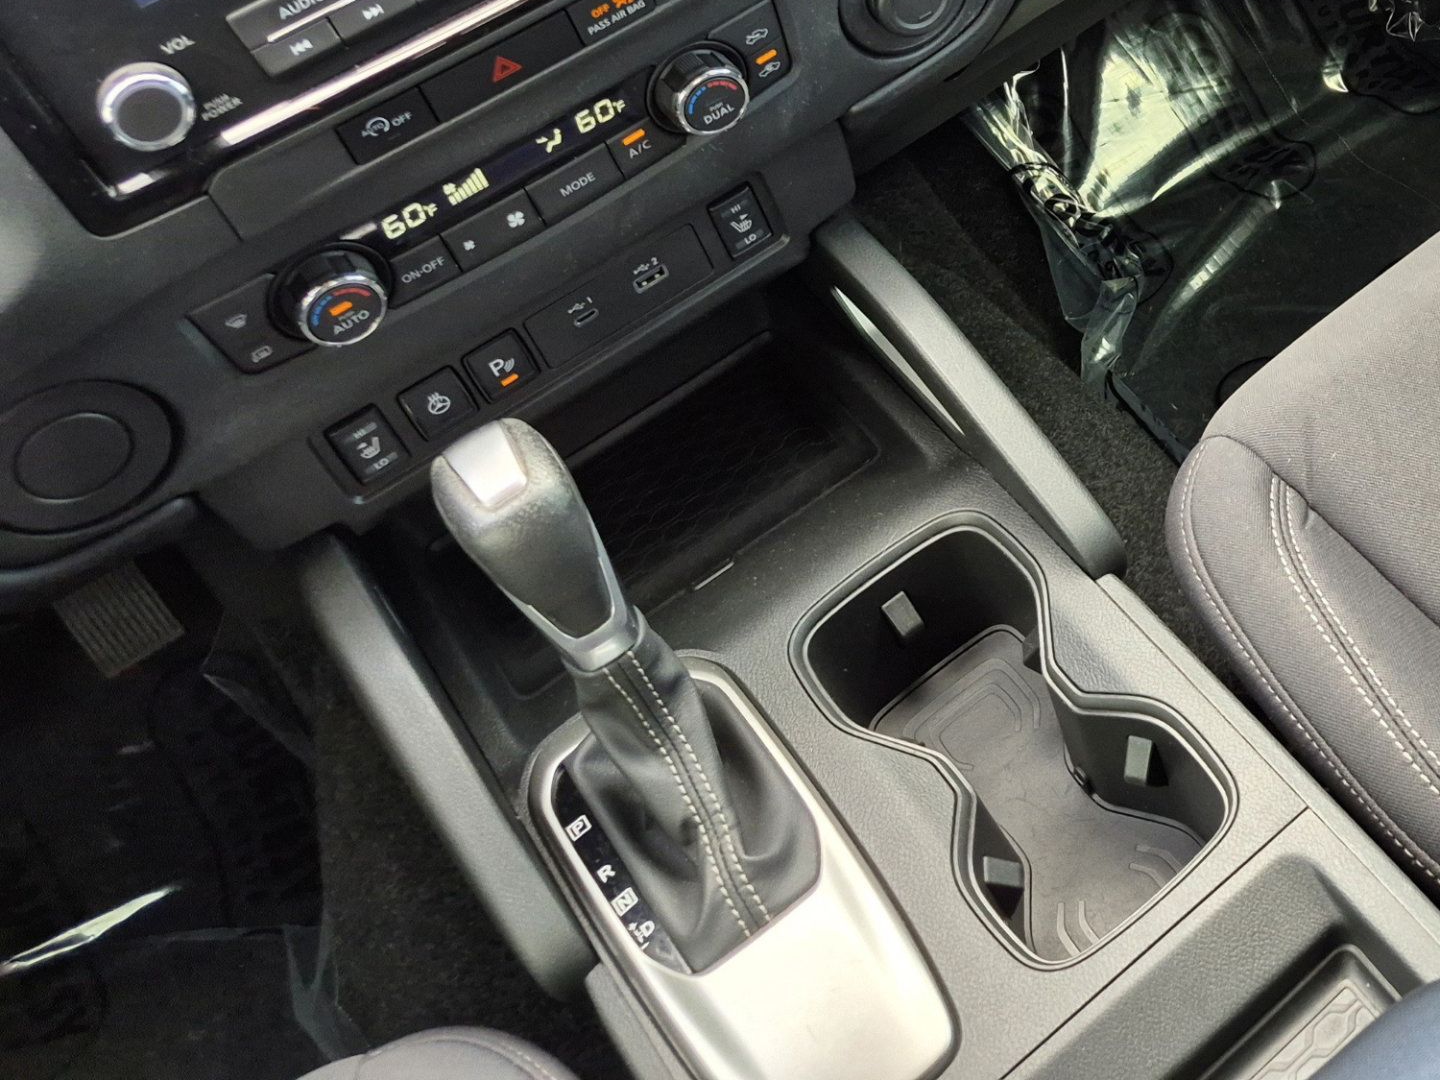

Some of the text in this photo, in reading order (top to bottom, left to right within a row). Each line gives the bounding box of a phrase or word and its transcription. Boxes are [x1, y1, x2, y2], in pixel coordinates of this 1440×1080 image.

[587, 0, 646, 35] PASS AIR BAG
[591, 3, 610, 18] OFF
[159, 35, 195, 55] VOL
[703, 104, 735, 125] DUAL
[628, 139, 652, 159] A/C
[559, 171, 596, 198] MODE
[744, 233, 758, 245] LO
[333, 309, 370, 336] AUTO
[597, 864, 616, 883] R
[638, 920, 655, 938] D
